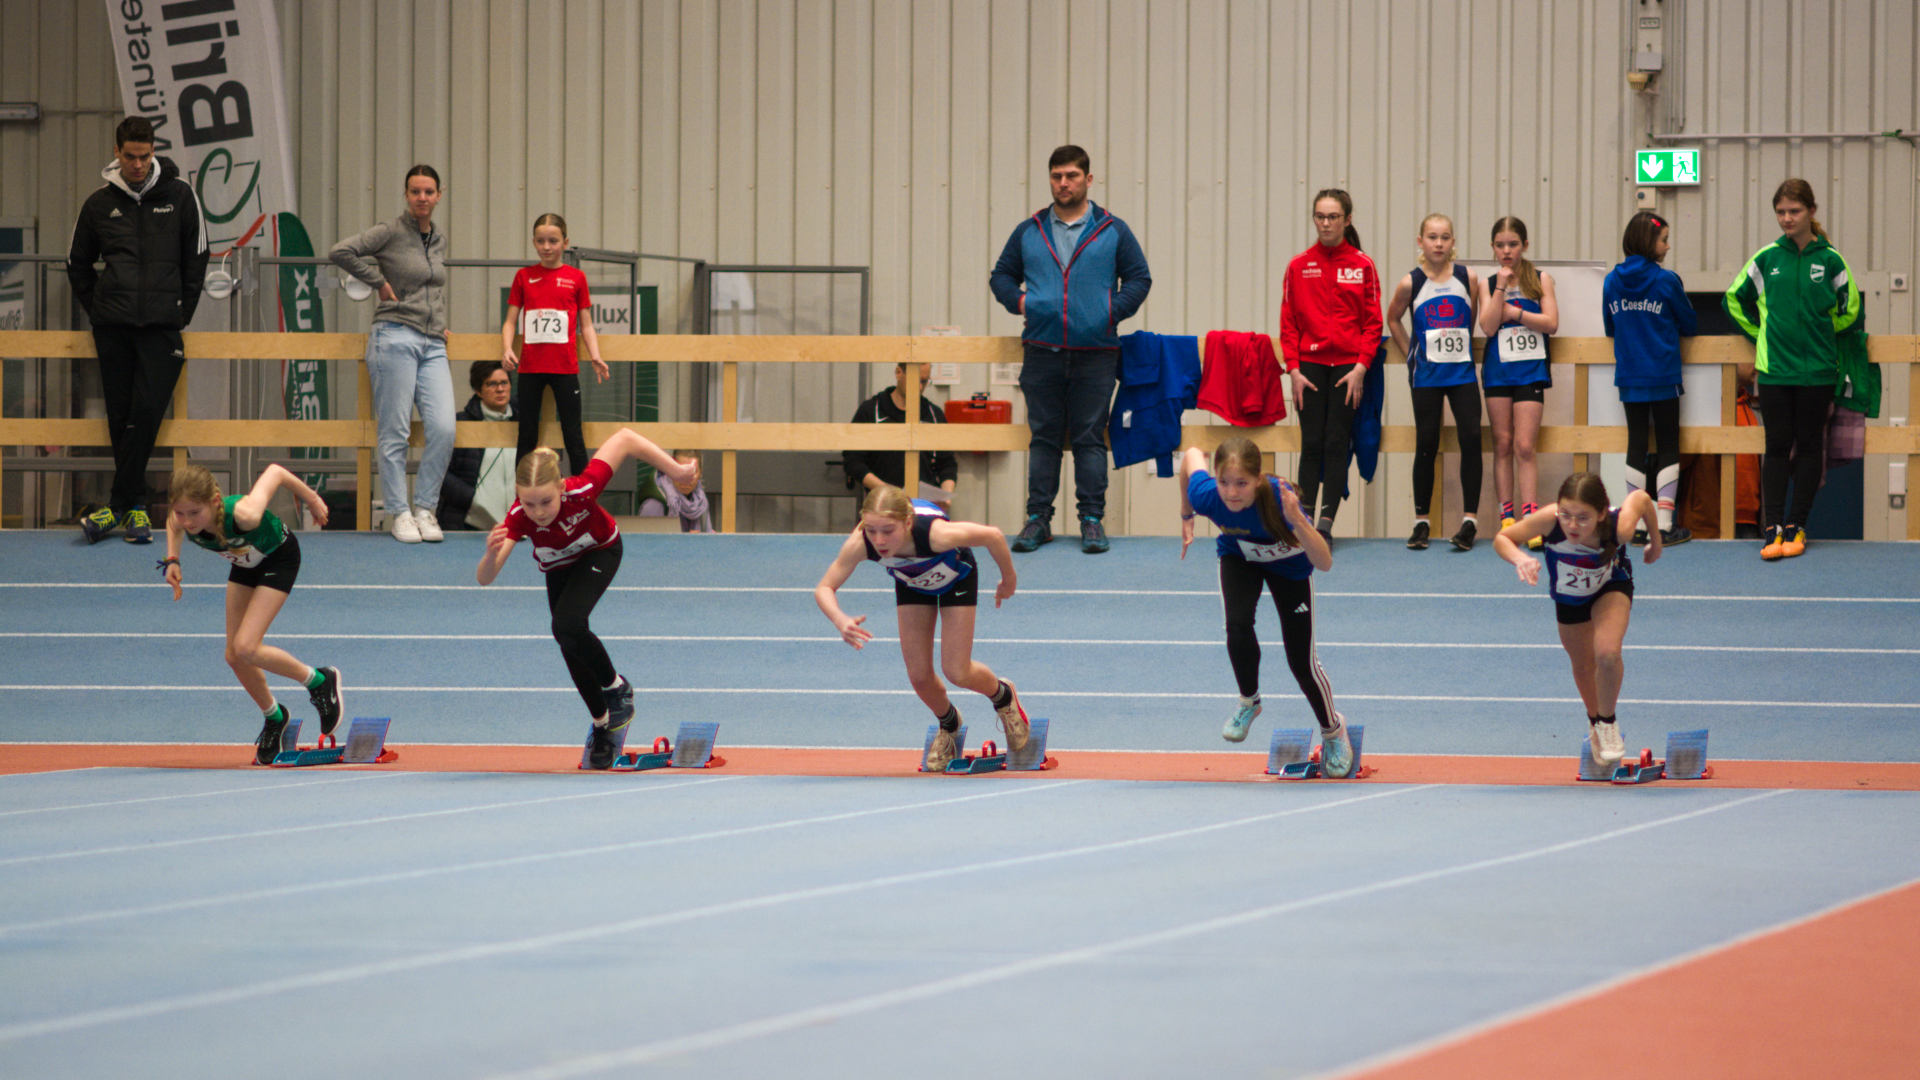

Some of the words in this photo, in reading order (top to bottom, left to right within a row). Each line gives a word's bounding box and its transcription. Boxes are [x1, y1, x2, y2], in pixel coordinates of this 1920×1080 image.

[590, 303, 629, 324] llux
[1621, 298, 1663, 315] Coesfeld
[532, 318, 562, 334] 173
[1434, 337, 1464, 353] 193
[1506, 334, 1538, 352] 199
[1566, 571, 1605, 589] 217
